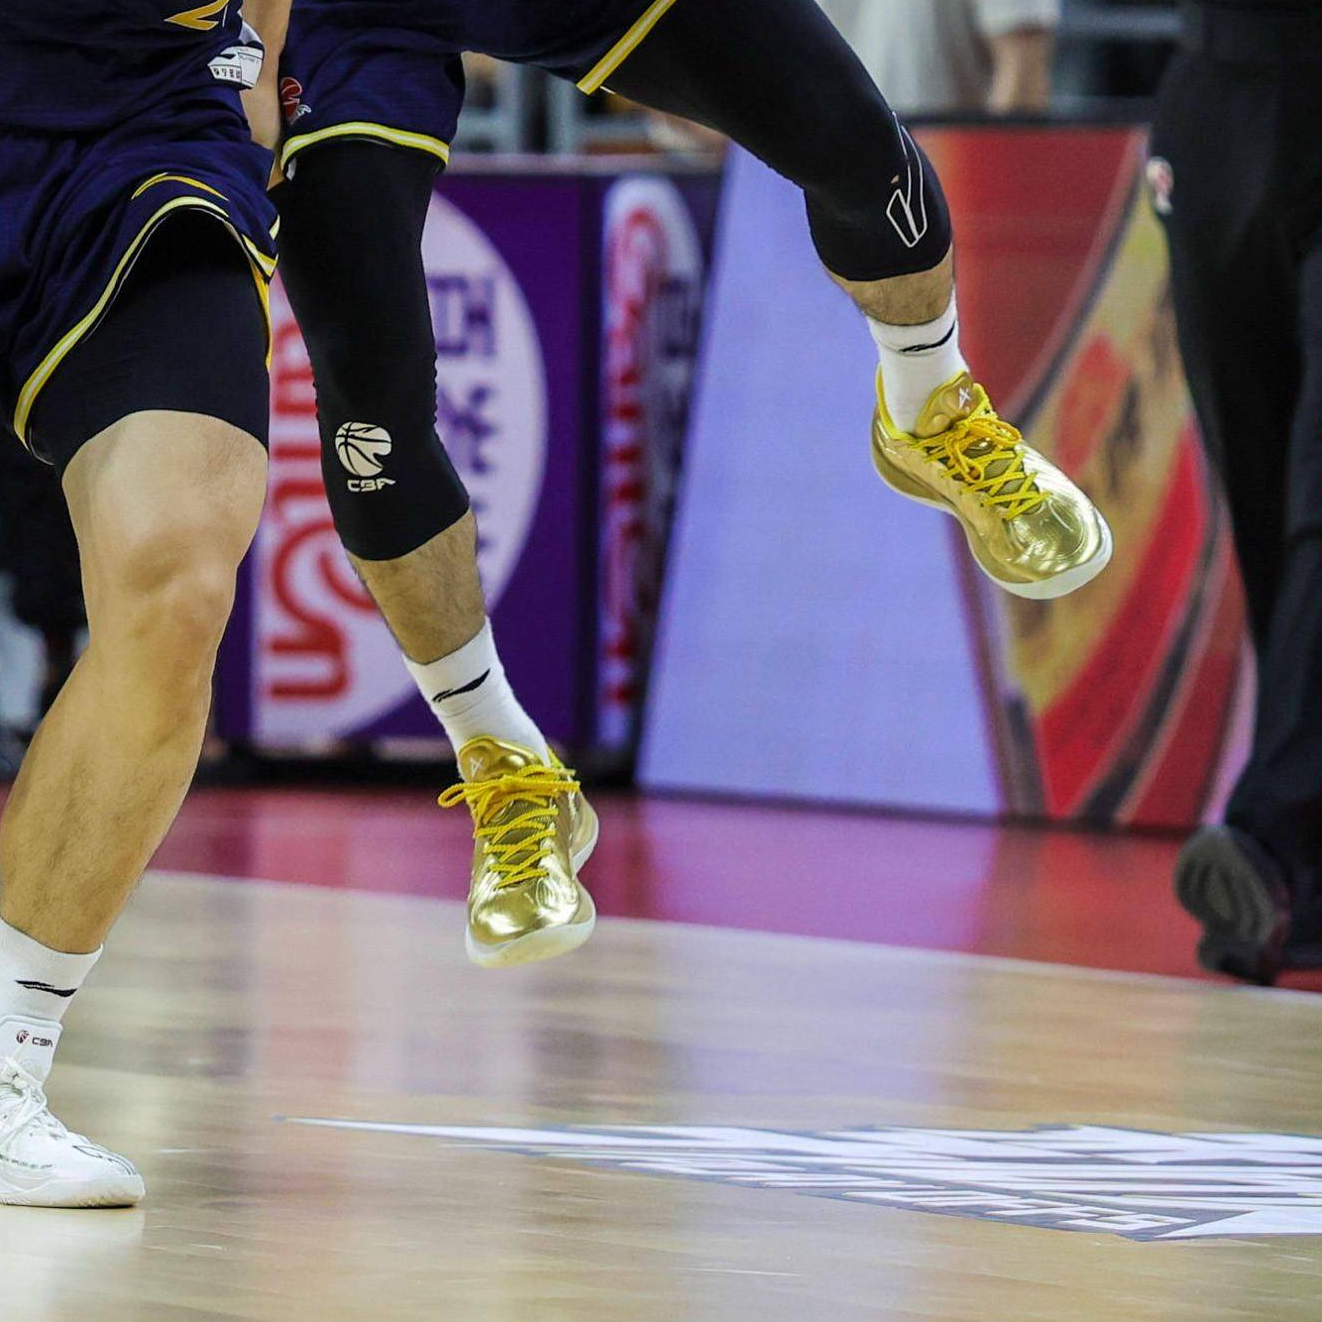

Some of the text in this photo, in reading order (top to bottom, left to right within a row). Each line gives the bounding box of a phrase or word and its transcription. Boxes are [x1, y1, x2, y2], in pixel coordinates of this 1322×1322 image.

[347, 478, 396, 492] CBA
[32, 1037, 54, 1047] CBA
[841, 1189, 1198, 1231] OFFS
